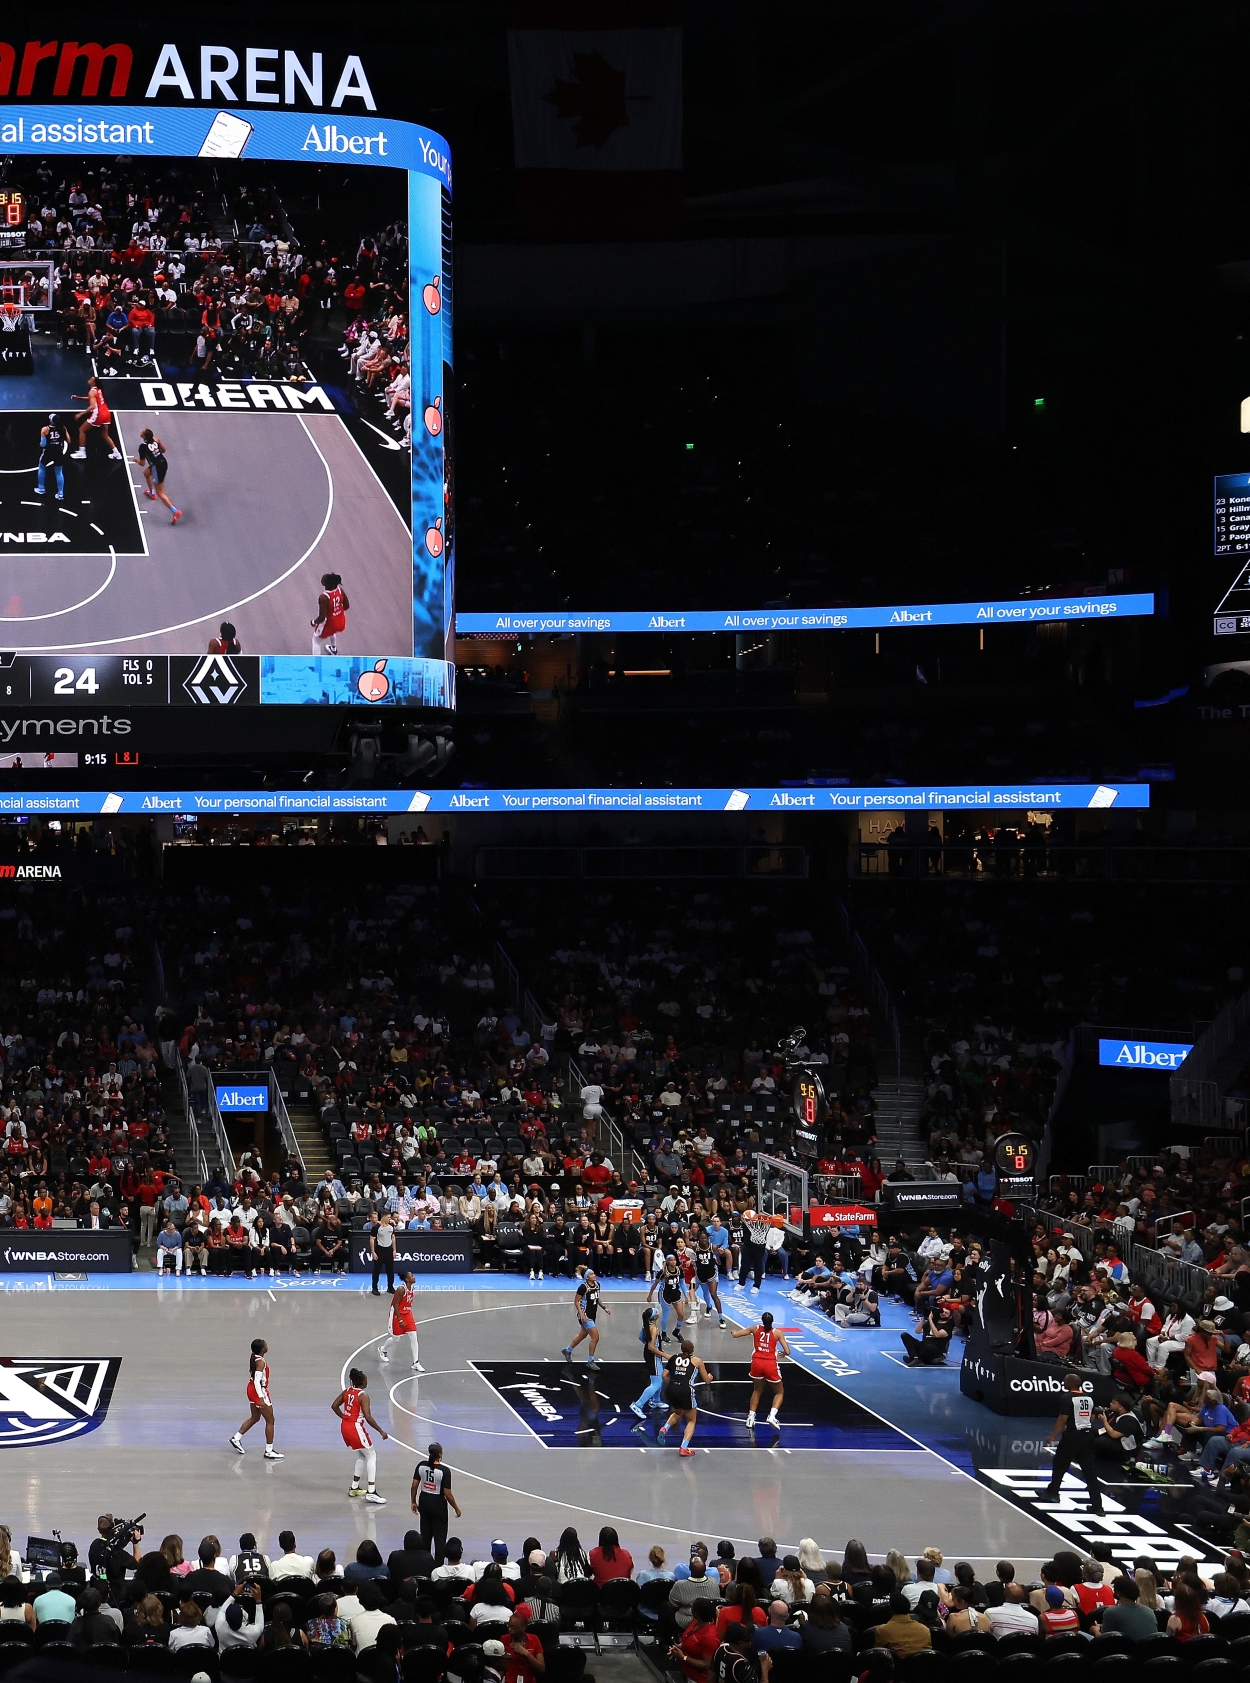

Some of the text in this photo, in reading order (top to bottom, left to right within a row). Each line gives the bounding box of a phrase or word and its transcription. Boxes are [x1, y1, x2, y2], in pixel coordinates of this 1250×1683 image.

[144, 43, 378, 111] ARENA
[32, 117, 154, 146] assistant
[300, 124, 388, 156] Albert
[418, 138, 448, 174] Your
[7, 204, 20, 224] 8
[1217, 544, 1231, 552] 2PT
[889, 611, 933, 623] Albert
[976, 602, 1117, 619] All over your savings
[495, 617, 611, 631] All over your savings
[648, 616, 686, 628] Albert
[724, 613, 848, 628] All over your savings
[123, 659, 153, 671] FLS 0
[53, 668, 100, 695] 24
[122, 673, 153, 685] TOL 5
[6, 685, 12, 695] 8
[84, 754, 107, 765] 9:15
[25, 797, 80, 810] assistant
[141, 796, 387, 811] Albert Your personal financial assistant
[449, 794, 702, 809] Albert Your personal financial assistant
[769, 791, 1062, 808] Albert Your personal financial assistant
[16, 865, 62, 878] ARENA
[220, 1091, 265, 1107] Albert
[806, 1098, 815, 1123] 8
[1005, 1145, 1028, 1156] 9:15
[1015, 1156, 1024, 1169] 8
[11, 1250, 109, 1262] WNBAStore.com
[759, 1331, 770, 1343] 21
[675, 1356, 690, 1367] 00
[347, 1393, 355, 1406] 12
[519, 1388, 564, 1422] WNBA
[1079, 1400, 1089, 1411] 36
[425, 1469, 434, 1483] 15
[242, 1557, 261, 1573] 15
[719, 1660, 726, 1679] 5
